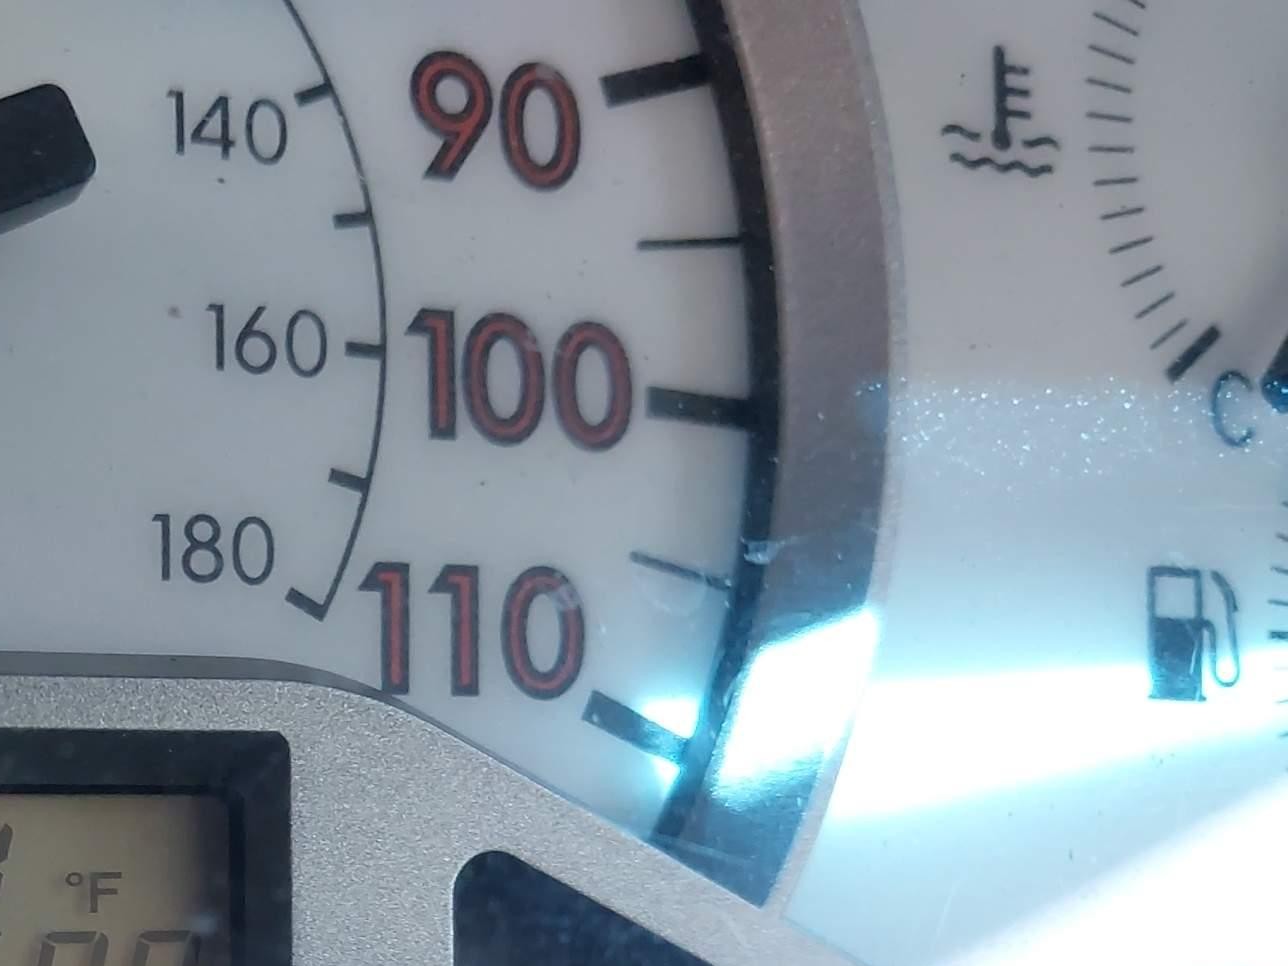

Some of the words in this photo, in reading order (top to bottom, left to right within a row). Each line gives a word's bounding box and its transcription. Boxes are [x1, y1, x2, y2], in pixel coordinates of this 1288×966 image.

[166, 89, 288, 166] 140
[409, 50, 581, 192] 90
[206, 303, 328, 378] 160
[404, 307, 634, 452] 100
[1211, 370, 1256, 448] C
[152, 513, 275, 586] 180
[358, 561, 585, 701] 110
